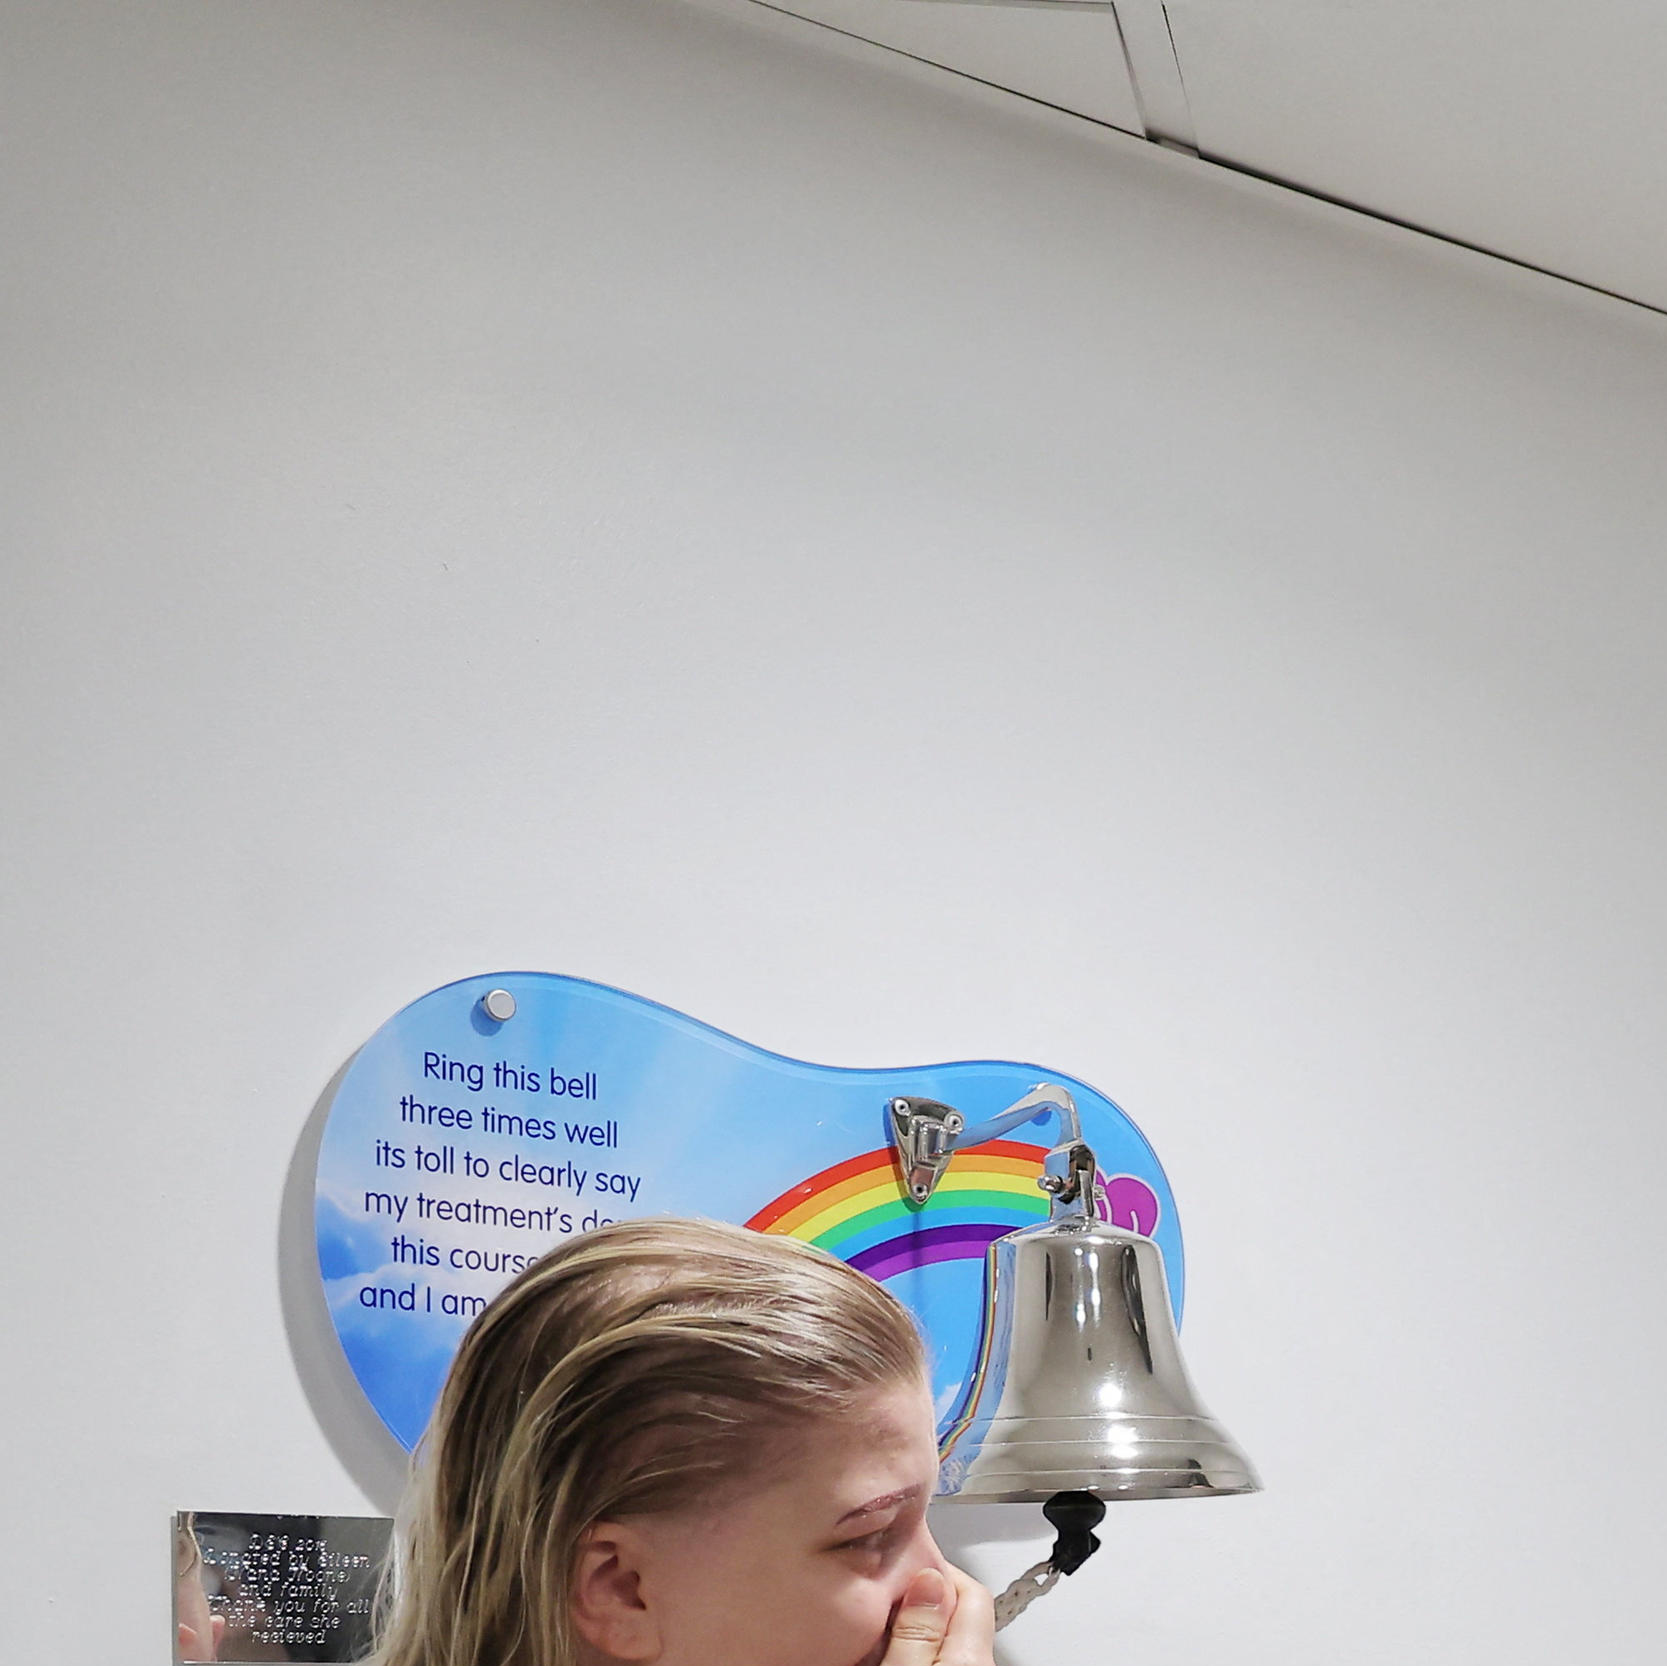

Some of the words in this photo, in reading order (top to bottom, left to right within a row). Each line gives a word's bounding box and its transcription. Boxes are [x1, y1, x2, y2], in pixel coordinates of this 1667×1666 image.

[423, 1052, 485, 1093] Ring
[493, 1060, 540, 1094] this
[551, 1067, 597, 1102] bell
[400, 1095, 474, 1132] three
[482, 1105, 557, 1140] times
[563, 1117, 618, 1149] well
[375, 1139, 406, 1171] its
[414, 1144, 457, 1176] toll
[464, 1149, 491, 1179] to
[498, 1152, 588, 1196] clearly
[595, 1170, 641, 1202] say
[365, 1192, 408, 1223] my
[392, 1235, 440, 1265] this
[360, 1283, 415, 1311] and
[427, 1287, 430, 1312] I
[441, 1293, 487, 1316] am
[289, 1552, 310, 1569] by
[240, 1582, 272, 1597] and
[280, 1582, 338, 1600] family
[229, 1613, 255, 1628] the
[265, 1617, 303, 1629] care
[310, 1614, 341, 1629] she
[274, 1601, 305, 1616] you
[313, 1599, 339, 1613] for
[346, 1600, 368, 1614] all
[251, 1630, 326, 1644] recieved
